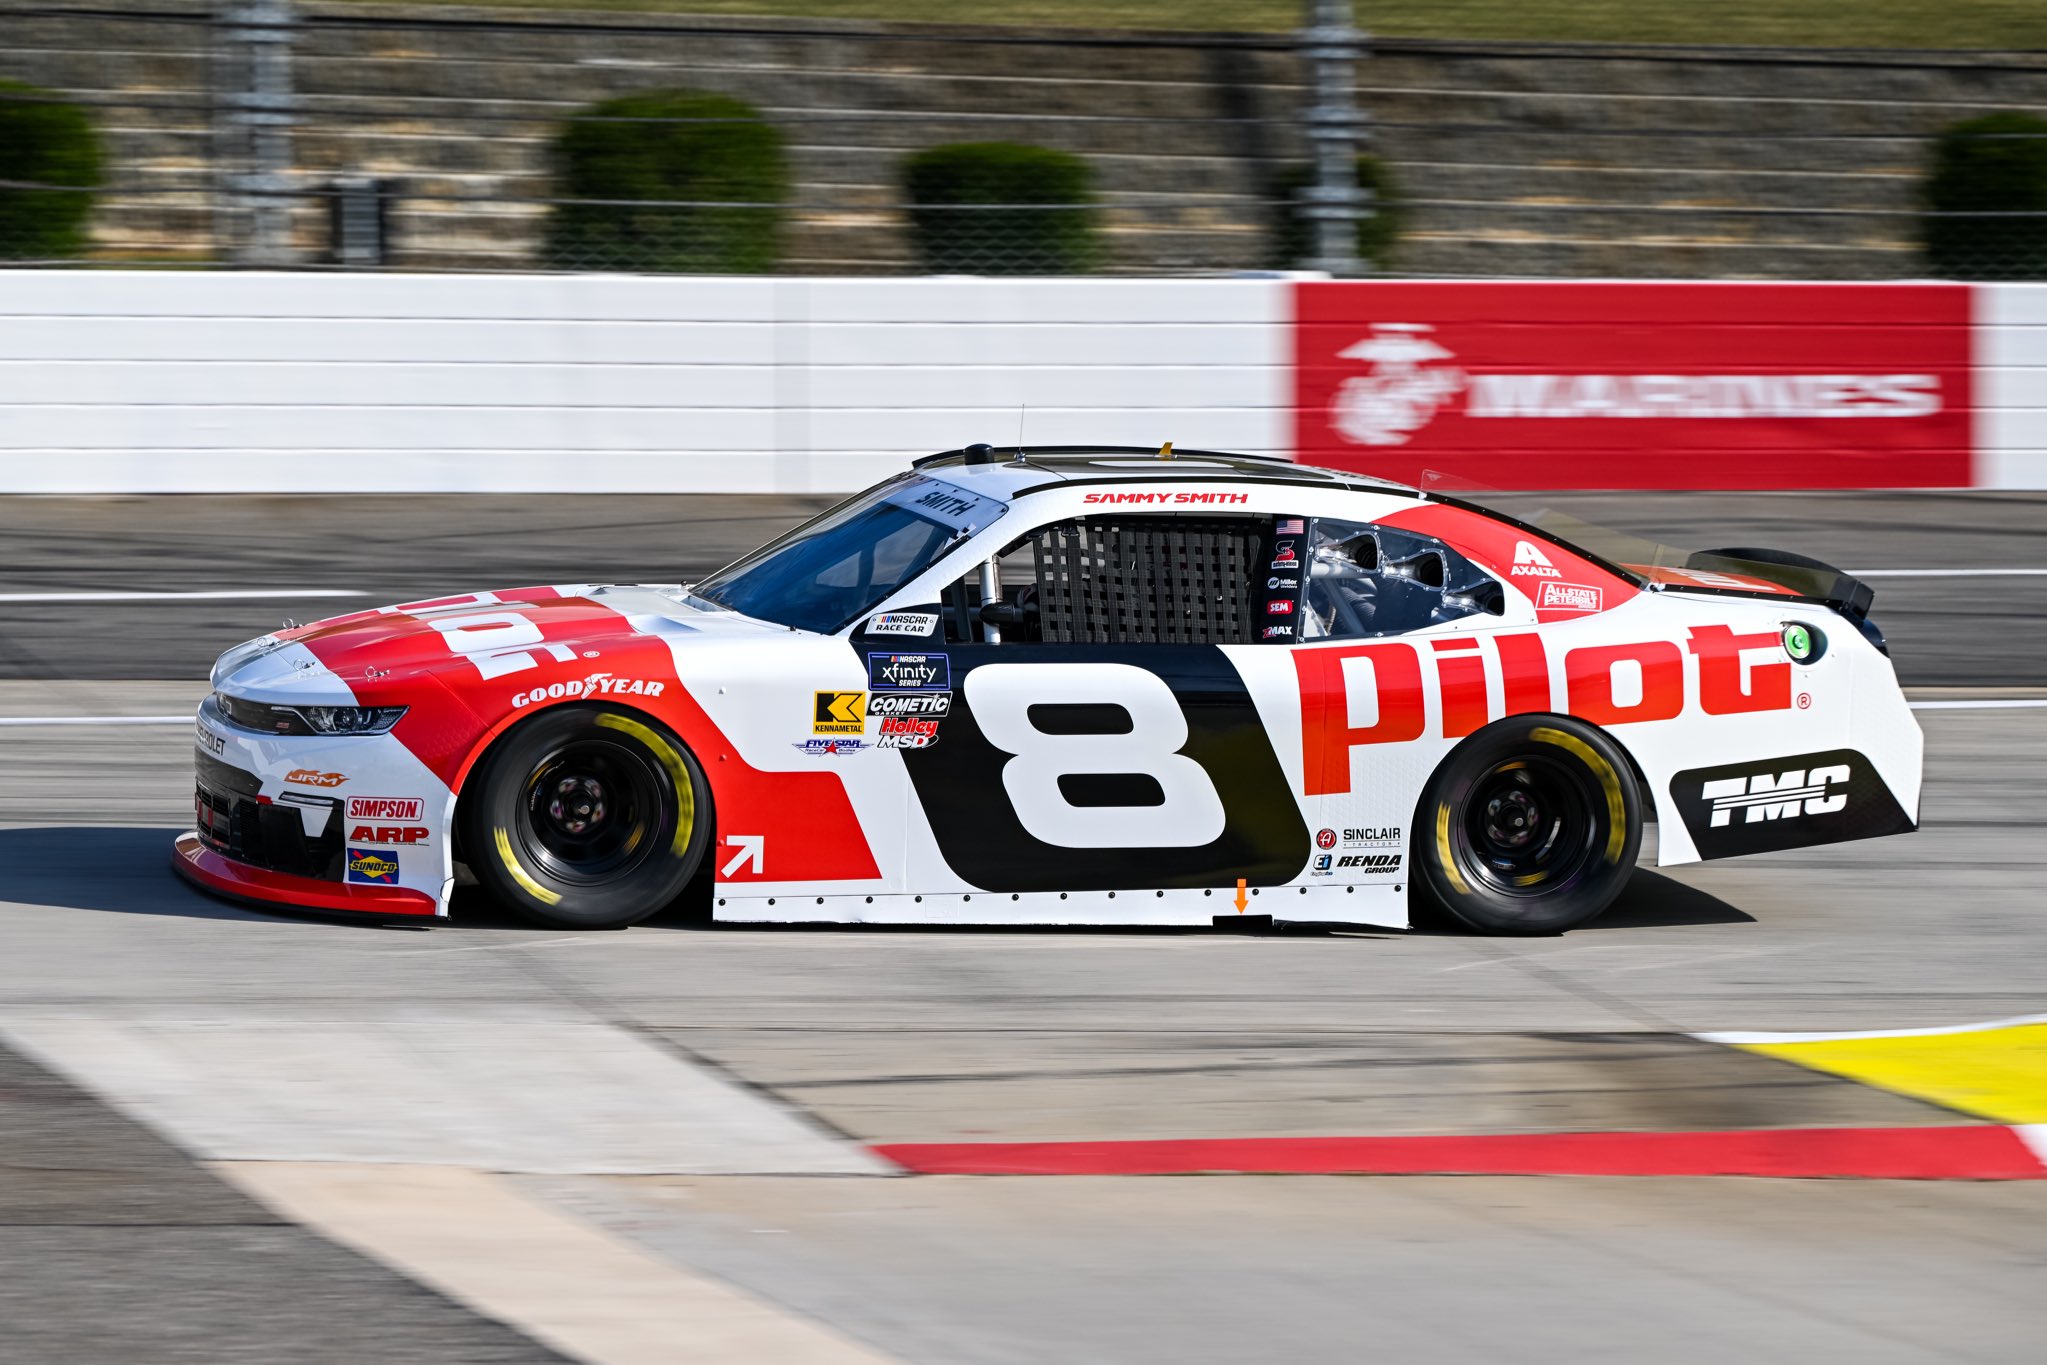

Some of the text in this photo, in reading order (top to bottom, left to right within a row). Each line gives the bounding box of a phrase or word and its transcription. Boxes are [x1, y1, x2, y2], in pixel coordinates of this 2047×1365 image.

[1467, 375, 1942, 417] MARINES
[915, 491, 976, 517] SMITH
[1084, 493, 1249, 504] SAMMY SMITH
[1510, 565, 1562, 578] AXALTA
[1270, 603, 1289, 612] SEM
[889, 615, 929, 625] NASCAR
[904, 625, 925, 633] CAR
[899, 655, 926, 663] NASCAR
[882, 663, 937, 683] xfinity
[898, 679, 922, 687] SERIES
[870, 697, 949, 712] COMETIC
[815, 724, 863, 733] KENNAMETAL
[881, 717, 939, 738] Holley
[196, 722, 226, 757] EVROLET
[805, 739, 862, 748] FIVE STAR
[877, 735, 930, 749] MSD
[963, 663, 1226, 848] 8
[288, 772, 338, 786] JRM
[1701, 764, 1851, 829] TMC
[350, 798, 418, 819] SIMPSON
[350, 826, 430, 843] ARP
[1343, 827, 1401, 840] SINCLAIR
[351, 861, 396, 873] SUNOCO
[1336, 854, 1403, 868] RENDA
